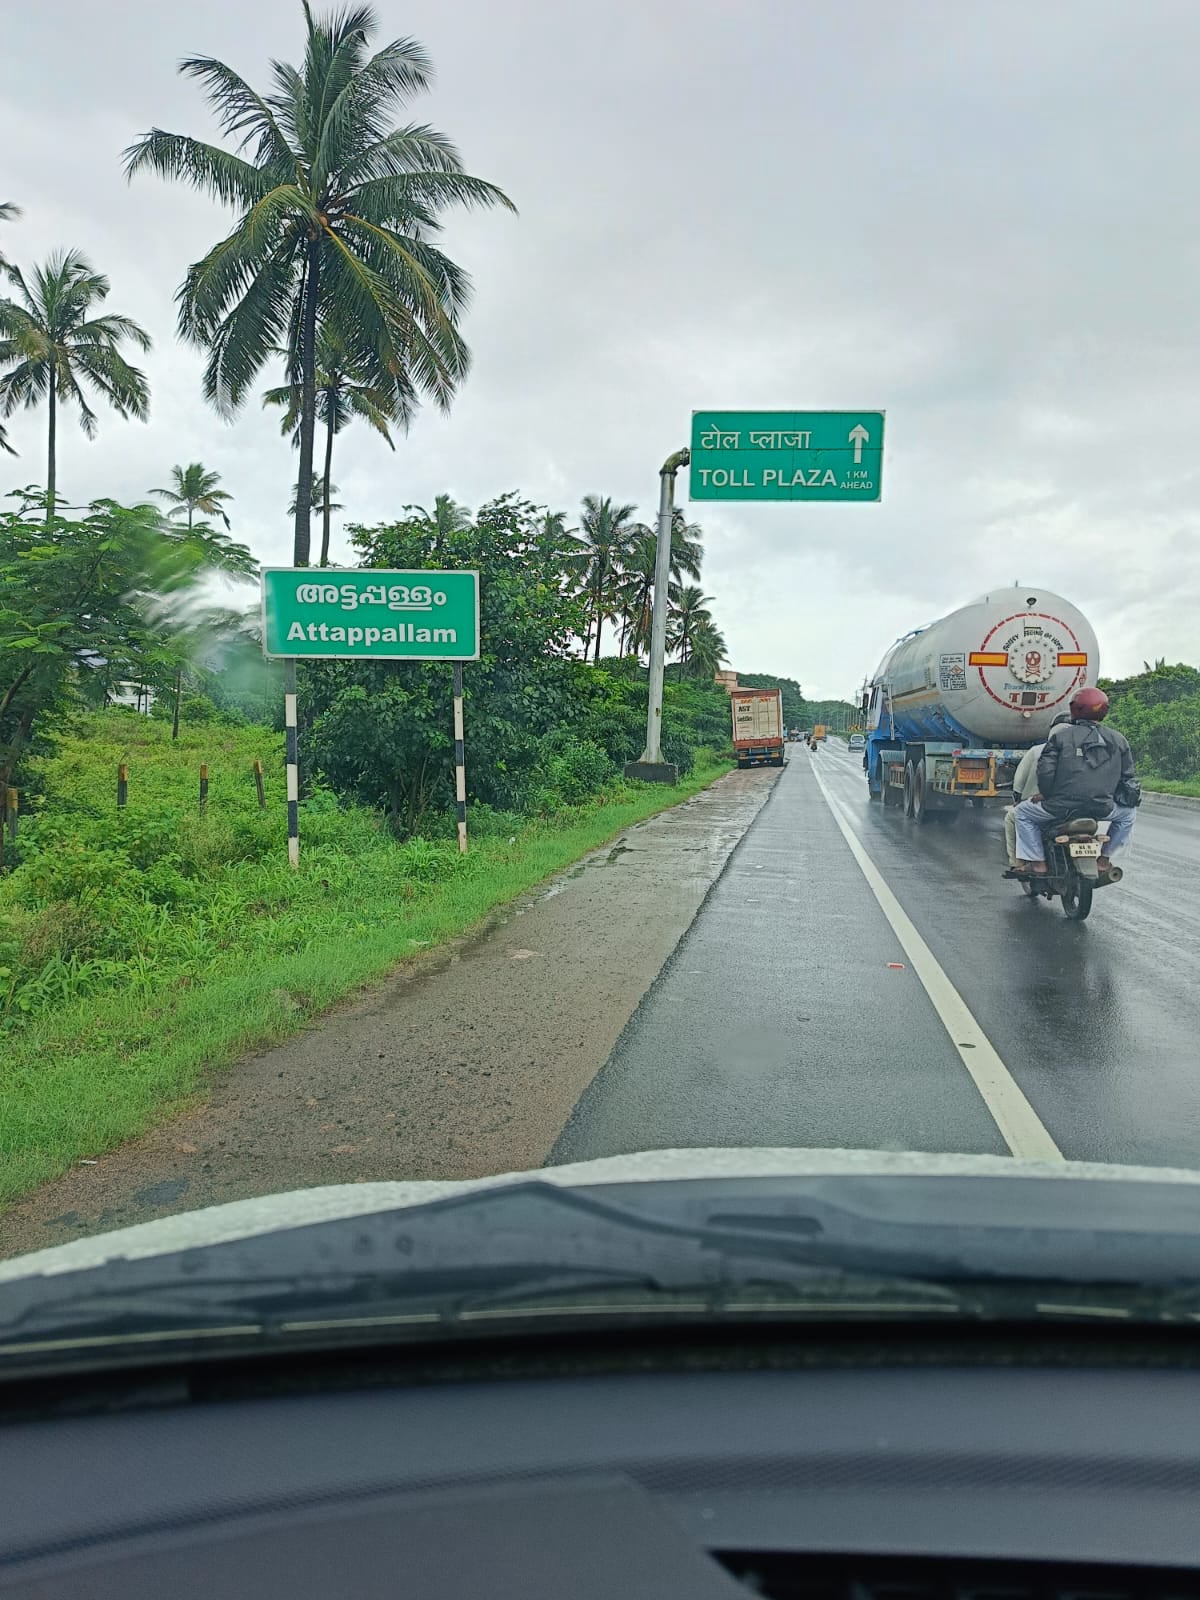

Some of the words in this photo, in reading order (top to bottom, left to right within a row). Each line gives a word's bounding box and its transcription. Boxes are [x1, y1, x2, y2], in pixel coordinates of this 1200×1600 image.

[700, 424, 742, 449] टोल
[749, 431, 813, 449] प्लाजा
[698, 469, 755, 487] TOLL
[762, 469, 838, 487] PLAZA
[840, 481, 873, 489] AHEAD
[846, 471, 850, 479] 1
[853, 471, 868, 479] KM
[296, 583, 447, 611] അട്ടപ്പള്ളം
[286, 621, 457, 647] Attappallam
